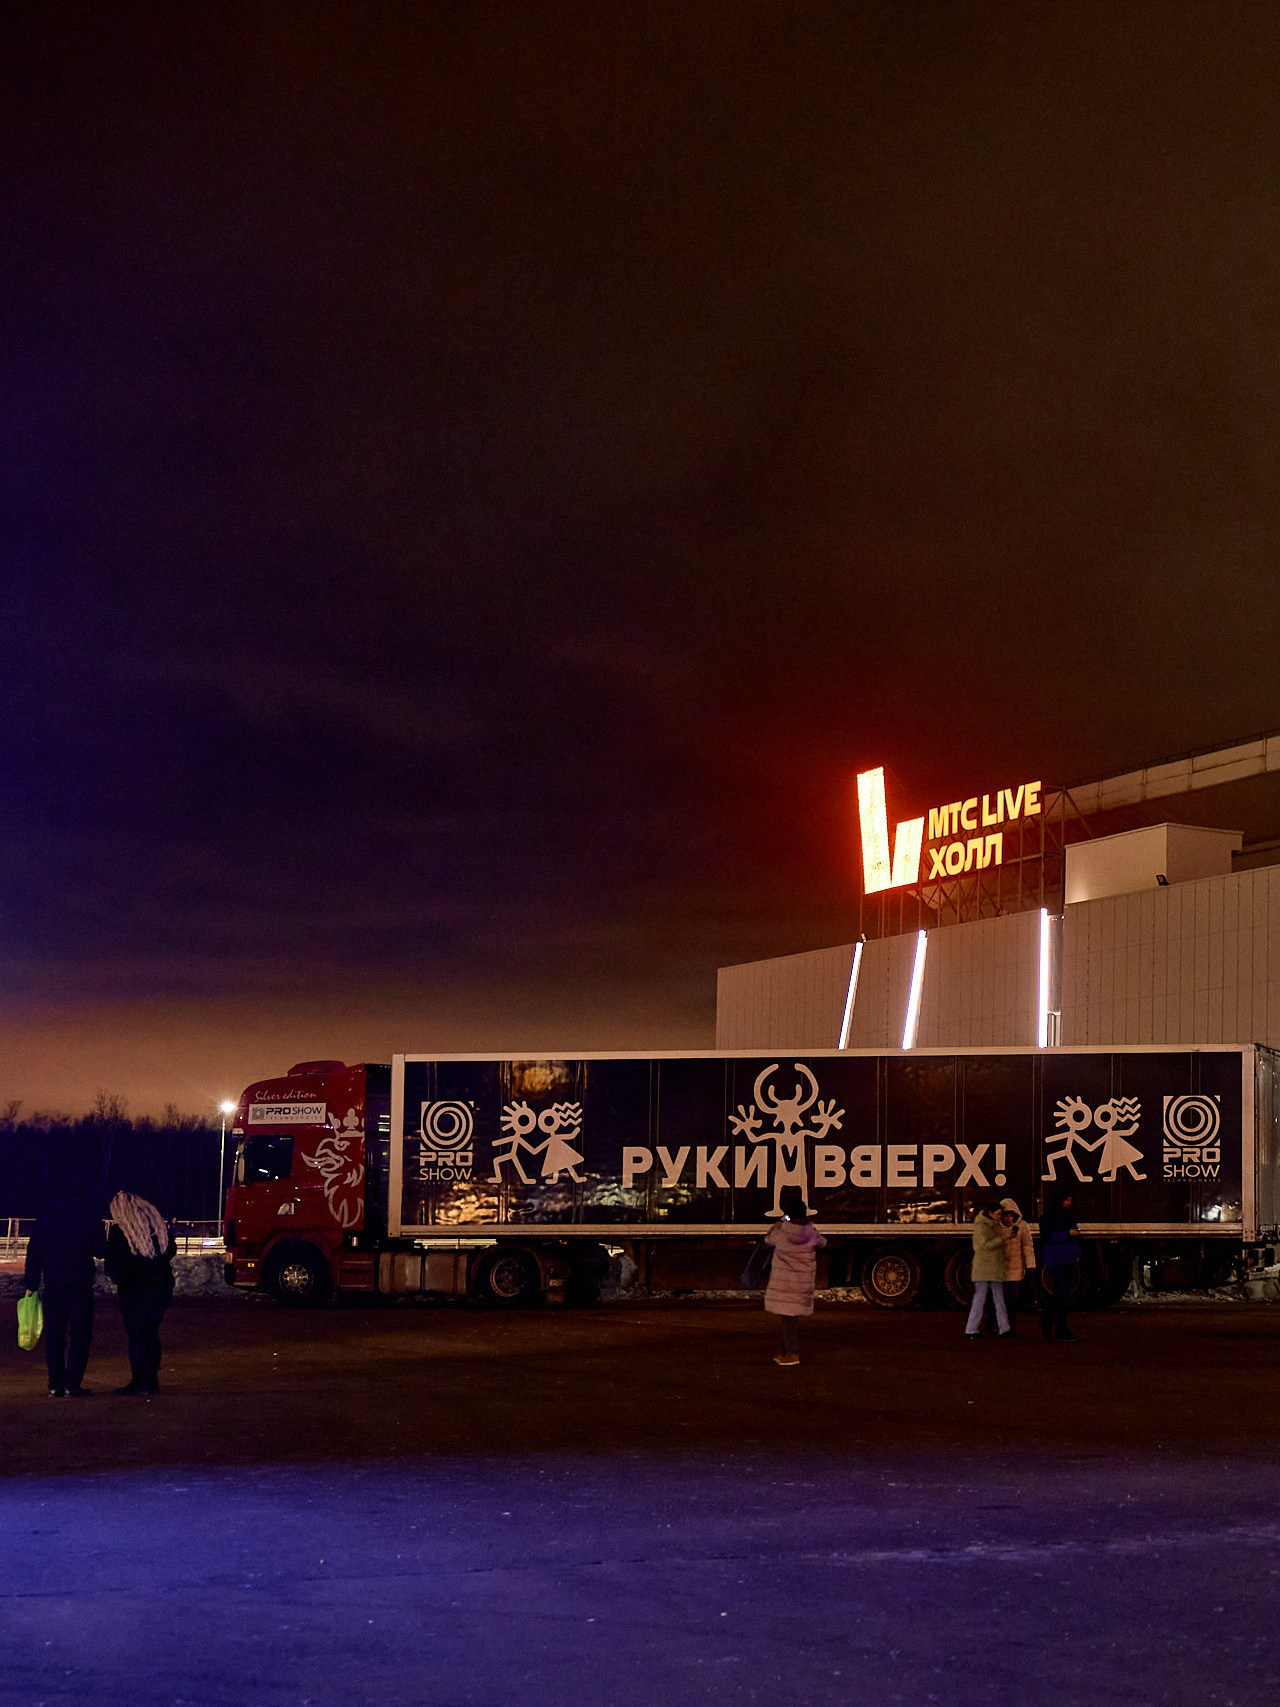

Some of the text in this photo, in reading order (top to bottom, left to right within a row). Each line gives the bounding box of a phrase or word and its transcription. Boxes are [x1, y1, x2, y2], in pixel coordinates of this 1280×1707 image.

[929, 780, 1042, 840] МТС LIVE
[929, 832, 1003, 880] ХОЛЛ
[254, 1089, 317, 1103] Silver edition
[420, 1151, 473, 1167] PRO
[1163, 1147, 1221, 1163] PRO
[419, 1167, 473, 1181] SHOW
[622, 1143, 1007, 1189] РУКИ ВВЕРХ!
[1163, 1164, 1221, 1178] SHOW
